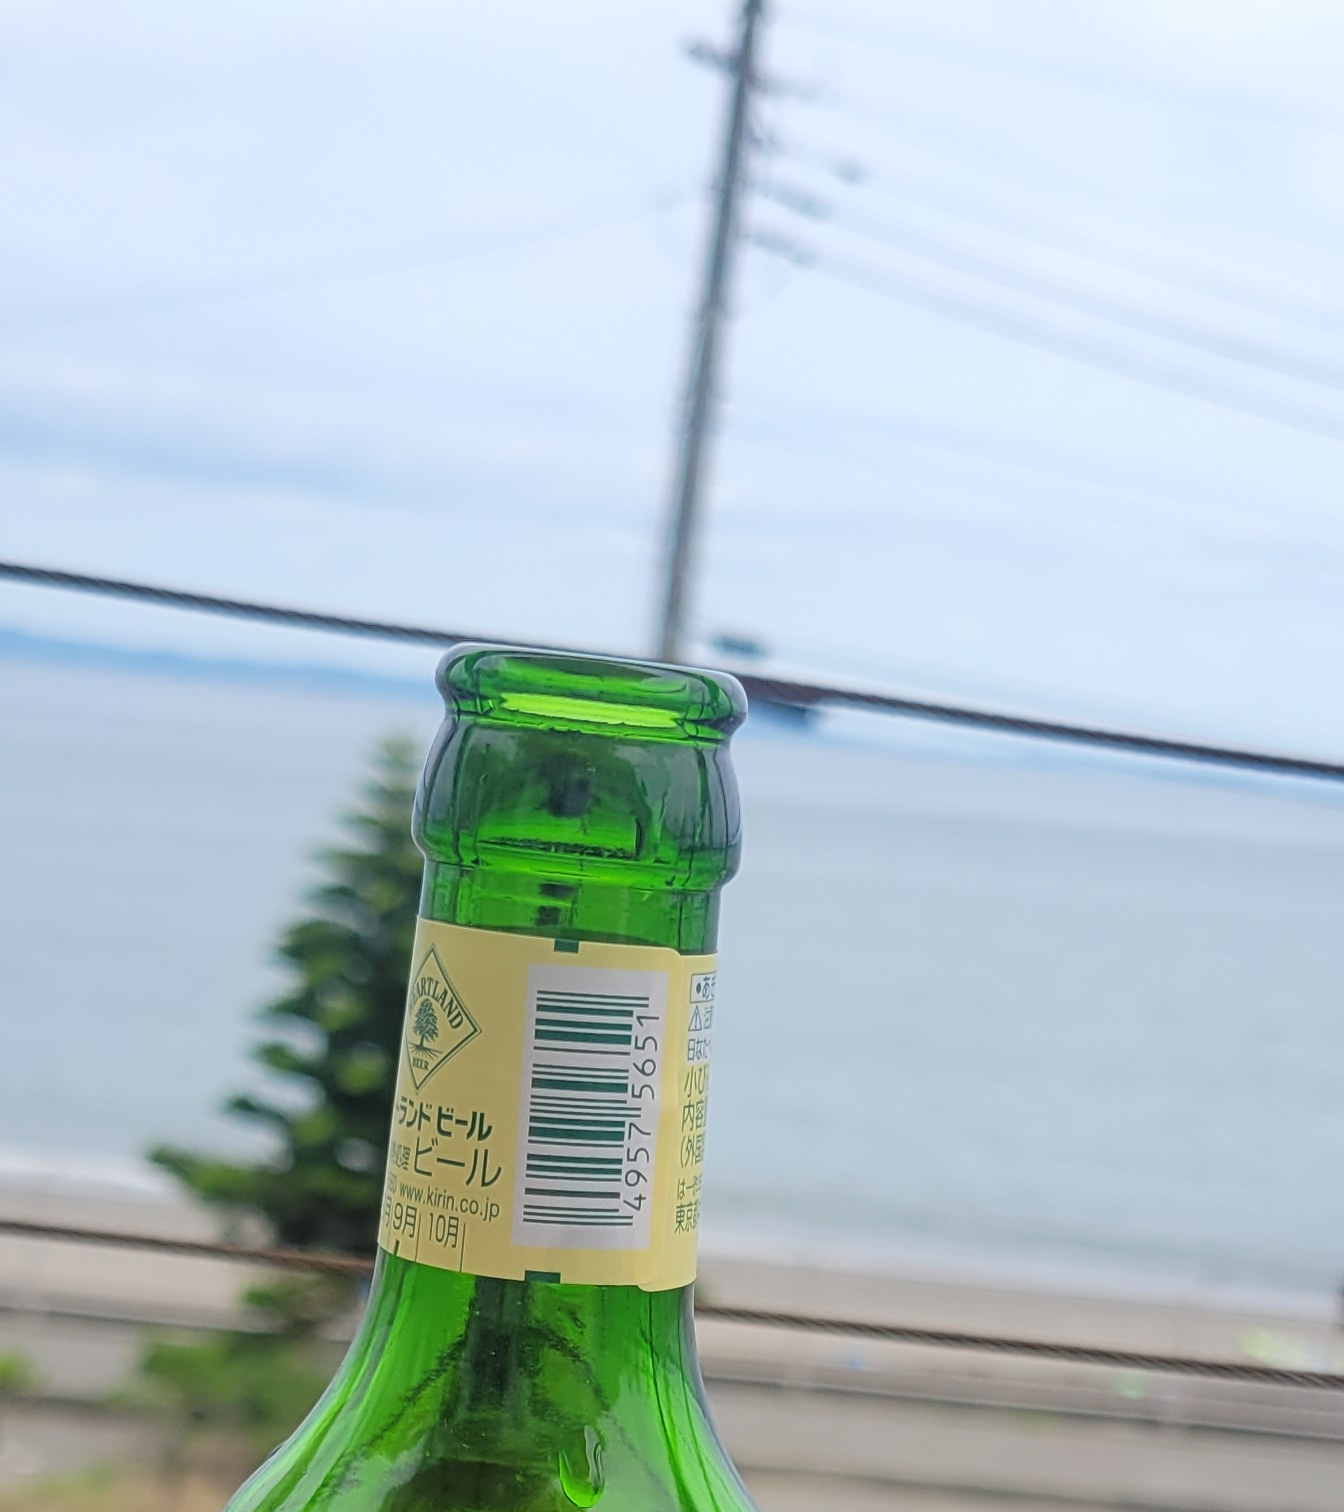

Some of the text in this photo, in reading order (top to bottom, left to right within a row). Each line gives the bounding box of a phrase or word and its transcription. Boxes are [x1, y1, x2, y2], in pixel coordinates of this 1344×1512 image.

[409, 977, 464, 1029] ARTLAND
[393, 1202, 417, 1238] 9月
[429, 1212, 459, 1248] 10月
[400, 1185, 500, 1222] www.kirin.co.jp
